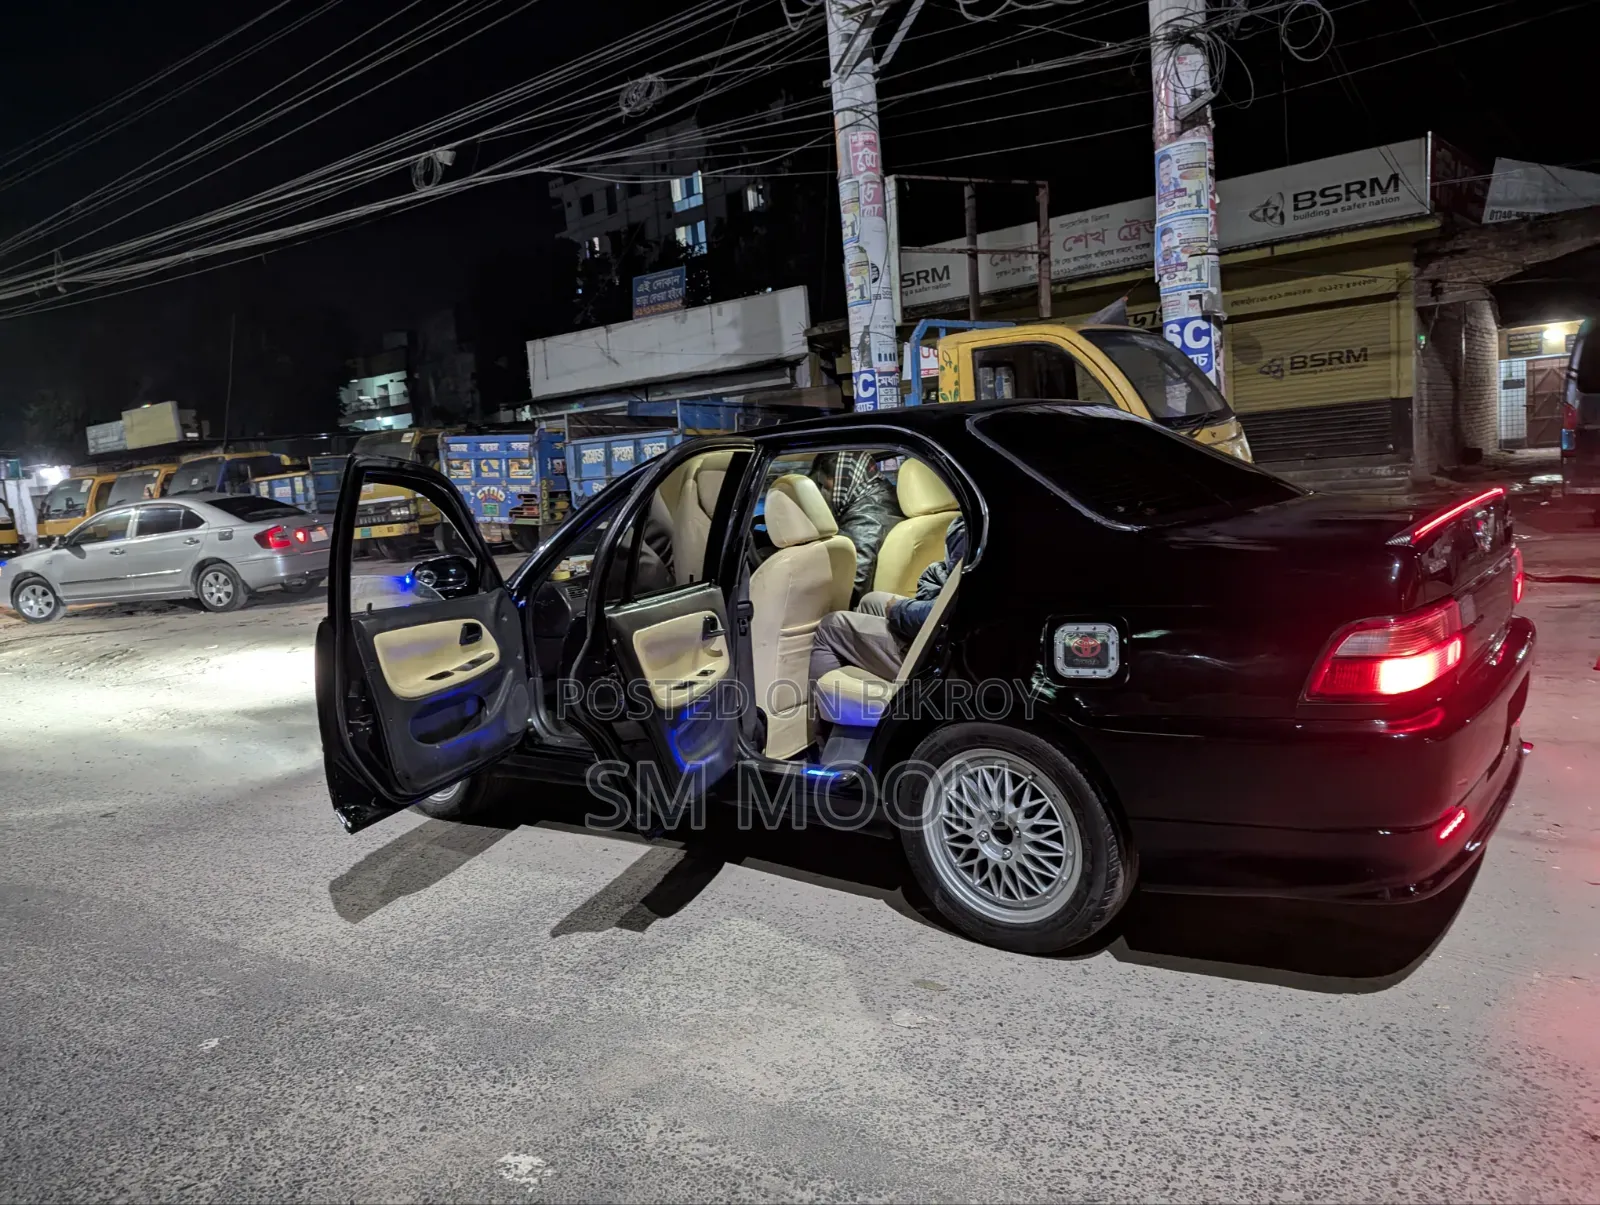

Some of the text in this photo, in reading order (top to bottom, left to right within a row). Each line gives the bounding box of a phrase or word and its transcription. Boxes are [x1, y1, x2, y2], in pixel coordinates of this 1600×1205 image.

[1293, 173, 1400, 212] BSRM
[1293, 206, 1330, 221] building
[1341, 201, 1366, 212] safer
[1369, 196, 1400, 207] nation
[1063, 227, 1109, 252] শেখ
[653, 275, 681, 290] দোকান
[901, 264, 950, 289] SRM
[1289, 346, 1368, 371] BSRM
[476, 486, 506, 502] STOP
